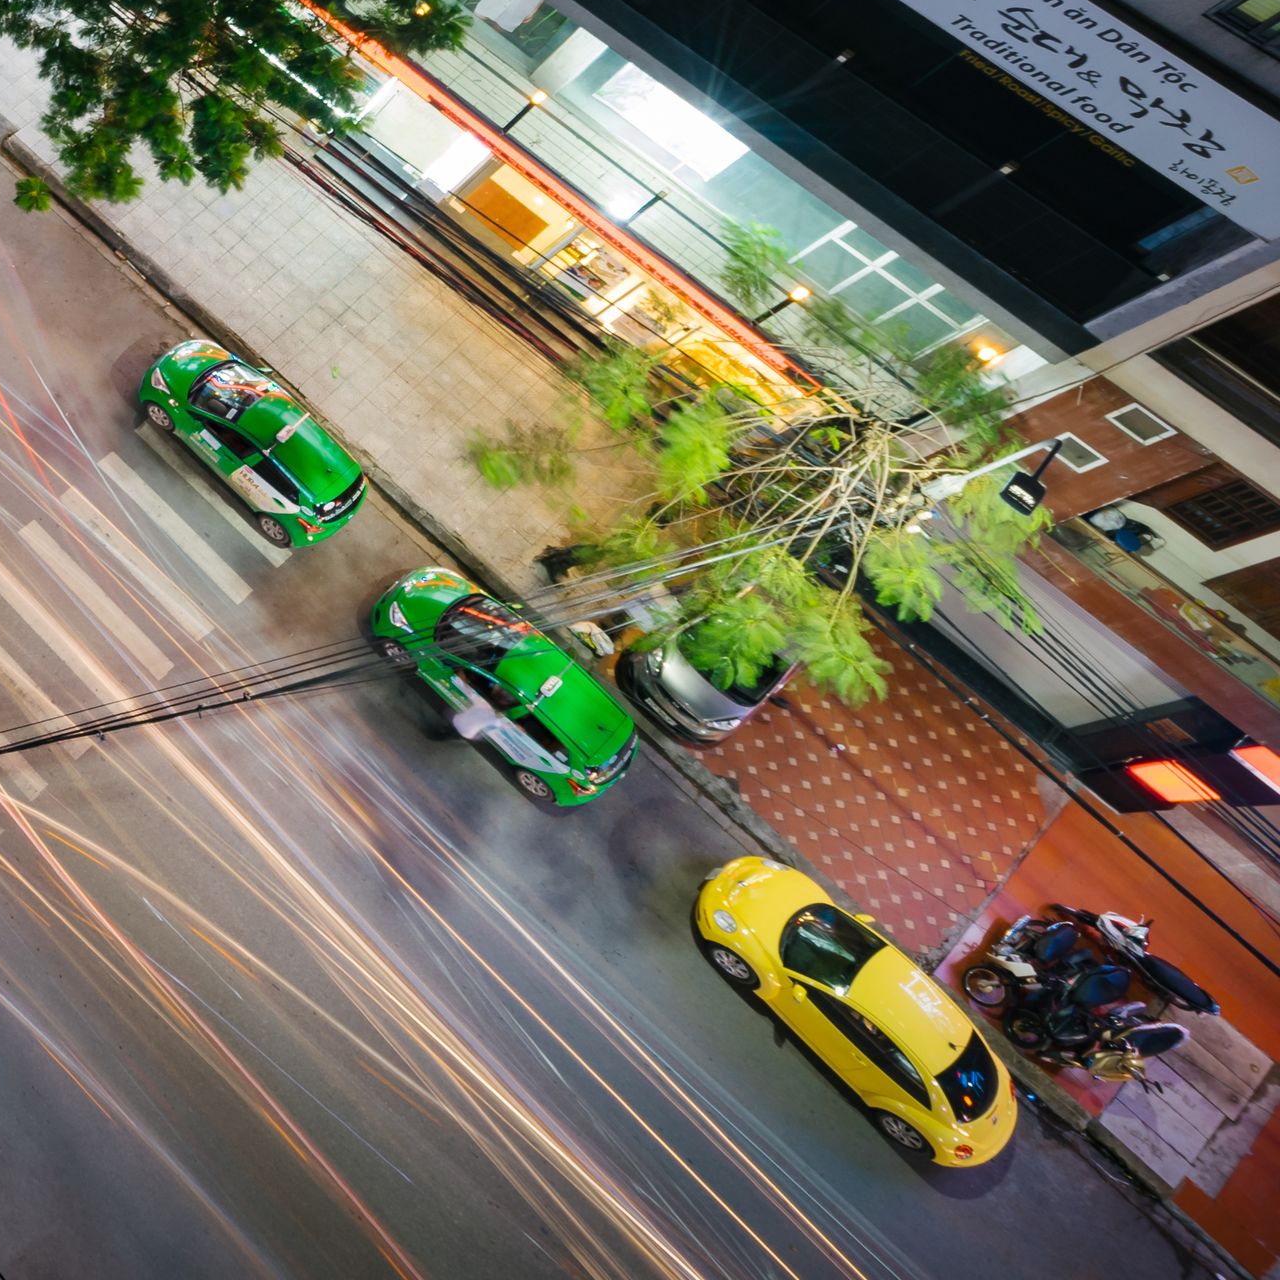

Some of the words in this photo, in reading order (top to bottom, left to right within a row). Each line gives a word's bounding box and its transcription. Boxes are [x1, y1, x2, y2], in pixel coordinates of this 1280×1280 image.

[950, 13, 1077, 99] Traditional
[1069, 95, 1135, 135] food
[1062, 7, 1097, 29] ăn
[1096, 27, 1152, 64] Dân
[1151, 60, 1199, 93] Tộc
